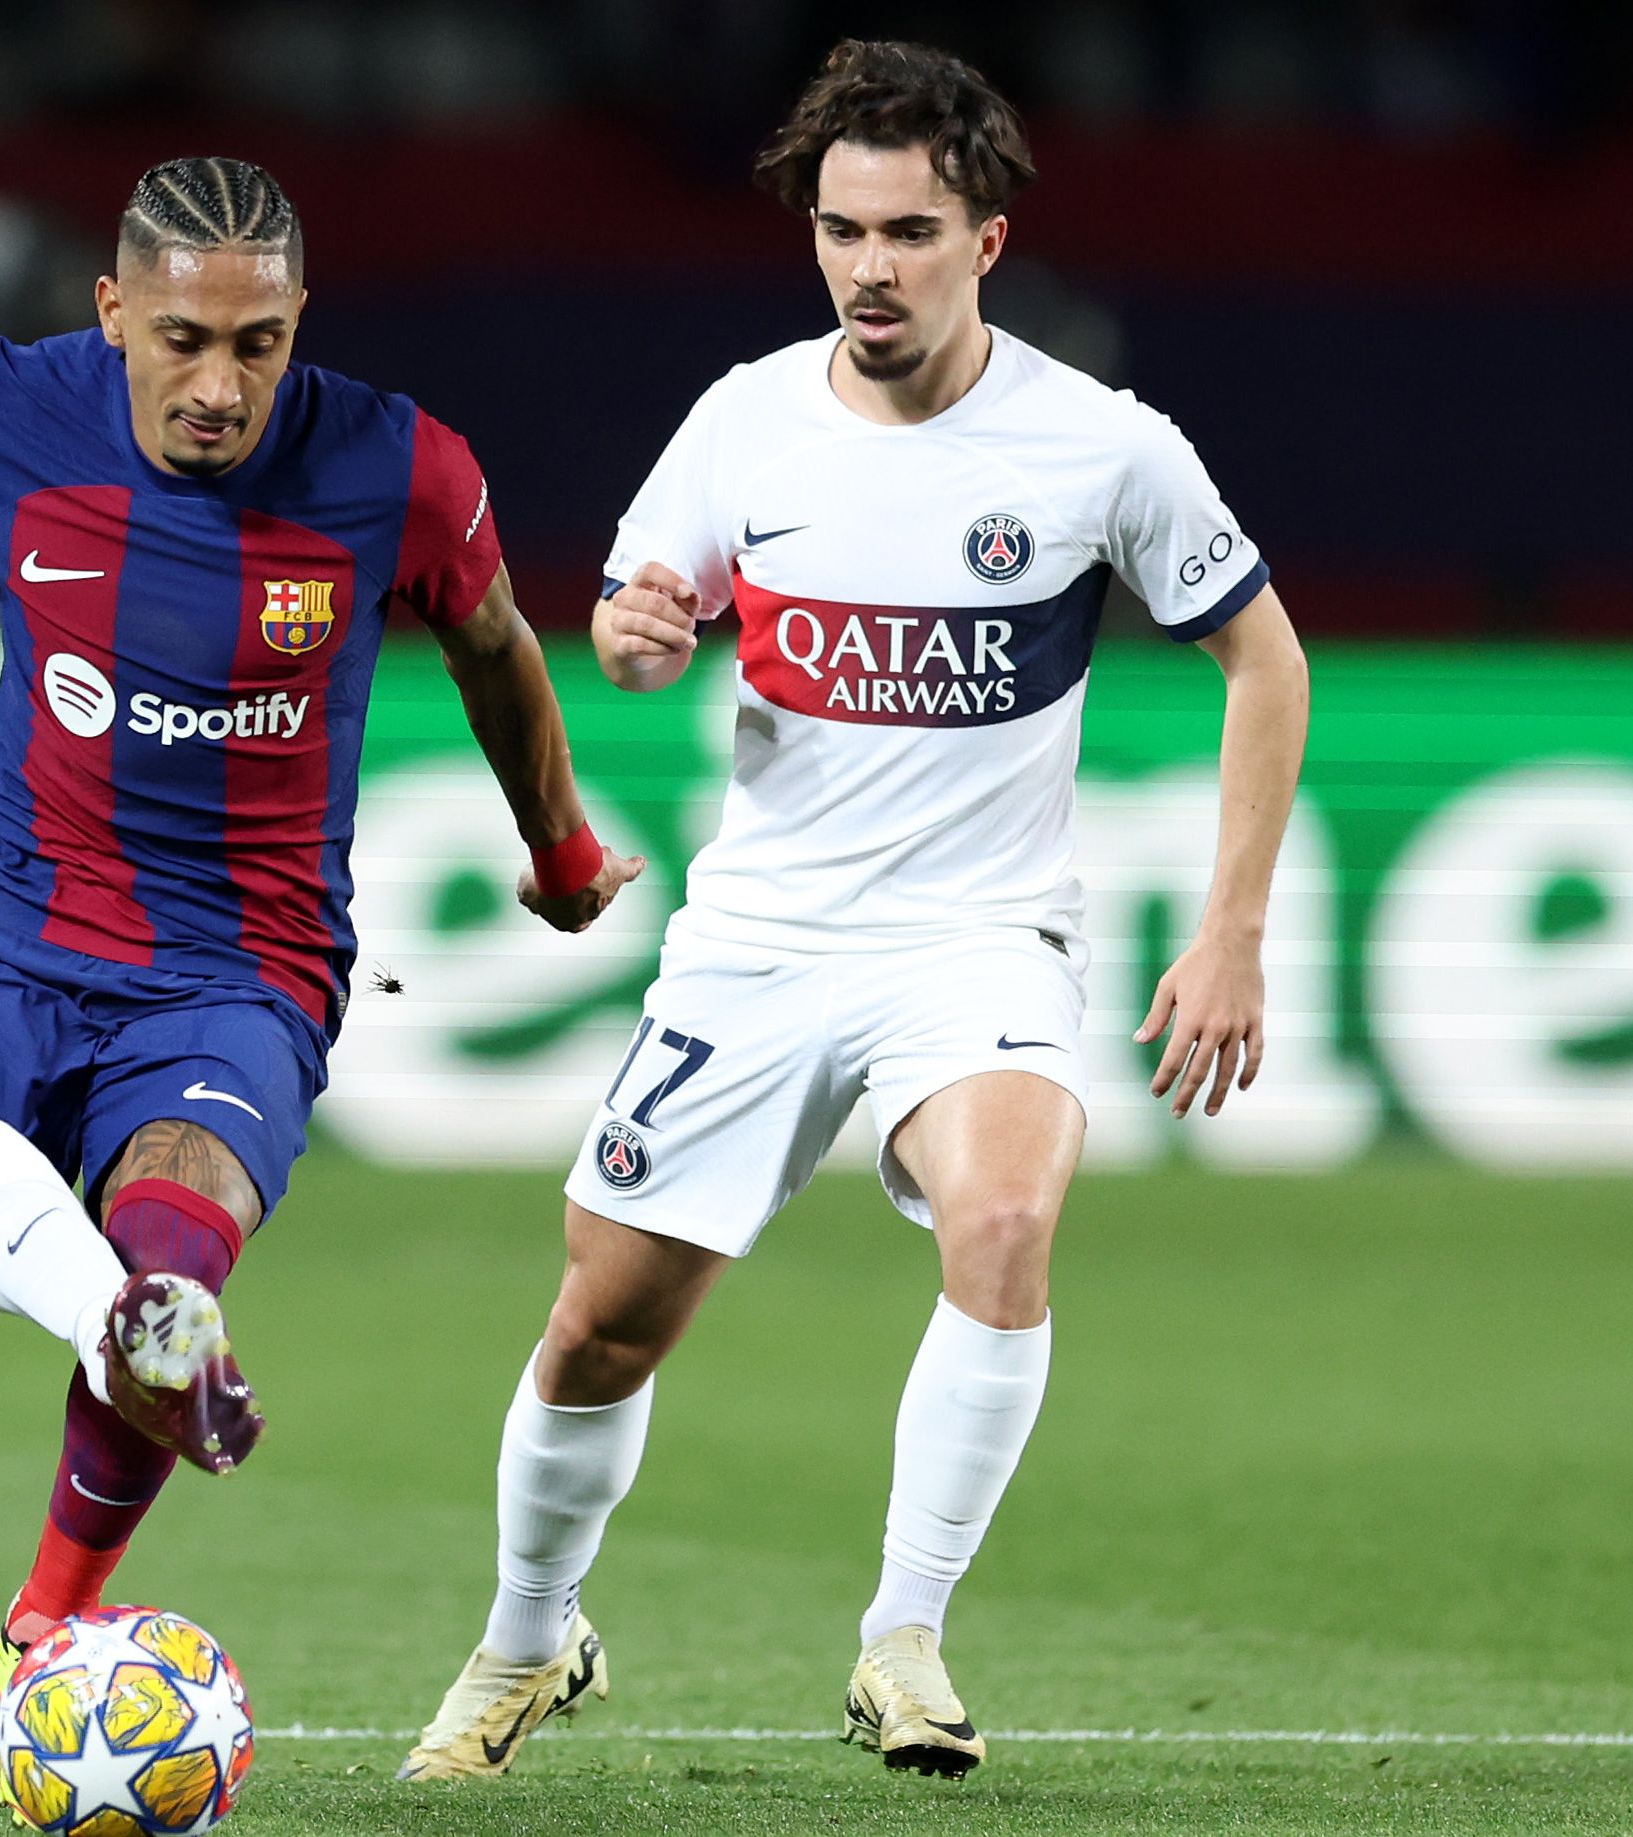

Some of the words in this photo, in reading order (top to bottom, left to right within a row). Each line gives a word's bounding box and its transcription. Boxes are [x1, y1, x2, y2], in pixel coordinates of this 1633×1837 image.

[975, 518, 1022, 536] PARIS
[1179, 530, 1243, 586] GO
[776, 607, 1017, 681] QATAR
[127, 691, 311, 746] Spotify
[826, 676, 1016, 716] AIRWAYS
[605, 1015, 716, 1129] 17
[606, 1127, 640, 1151] PARIS
